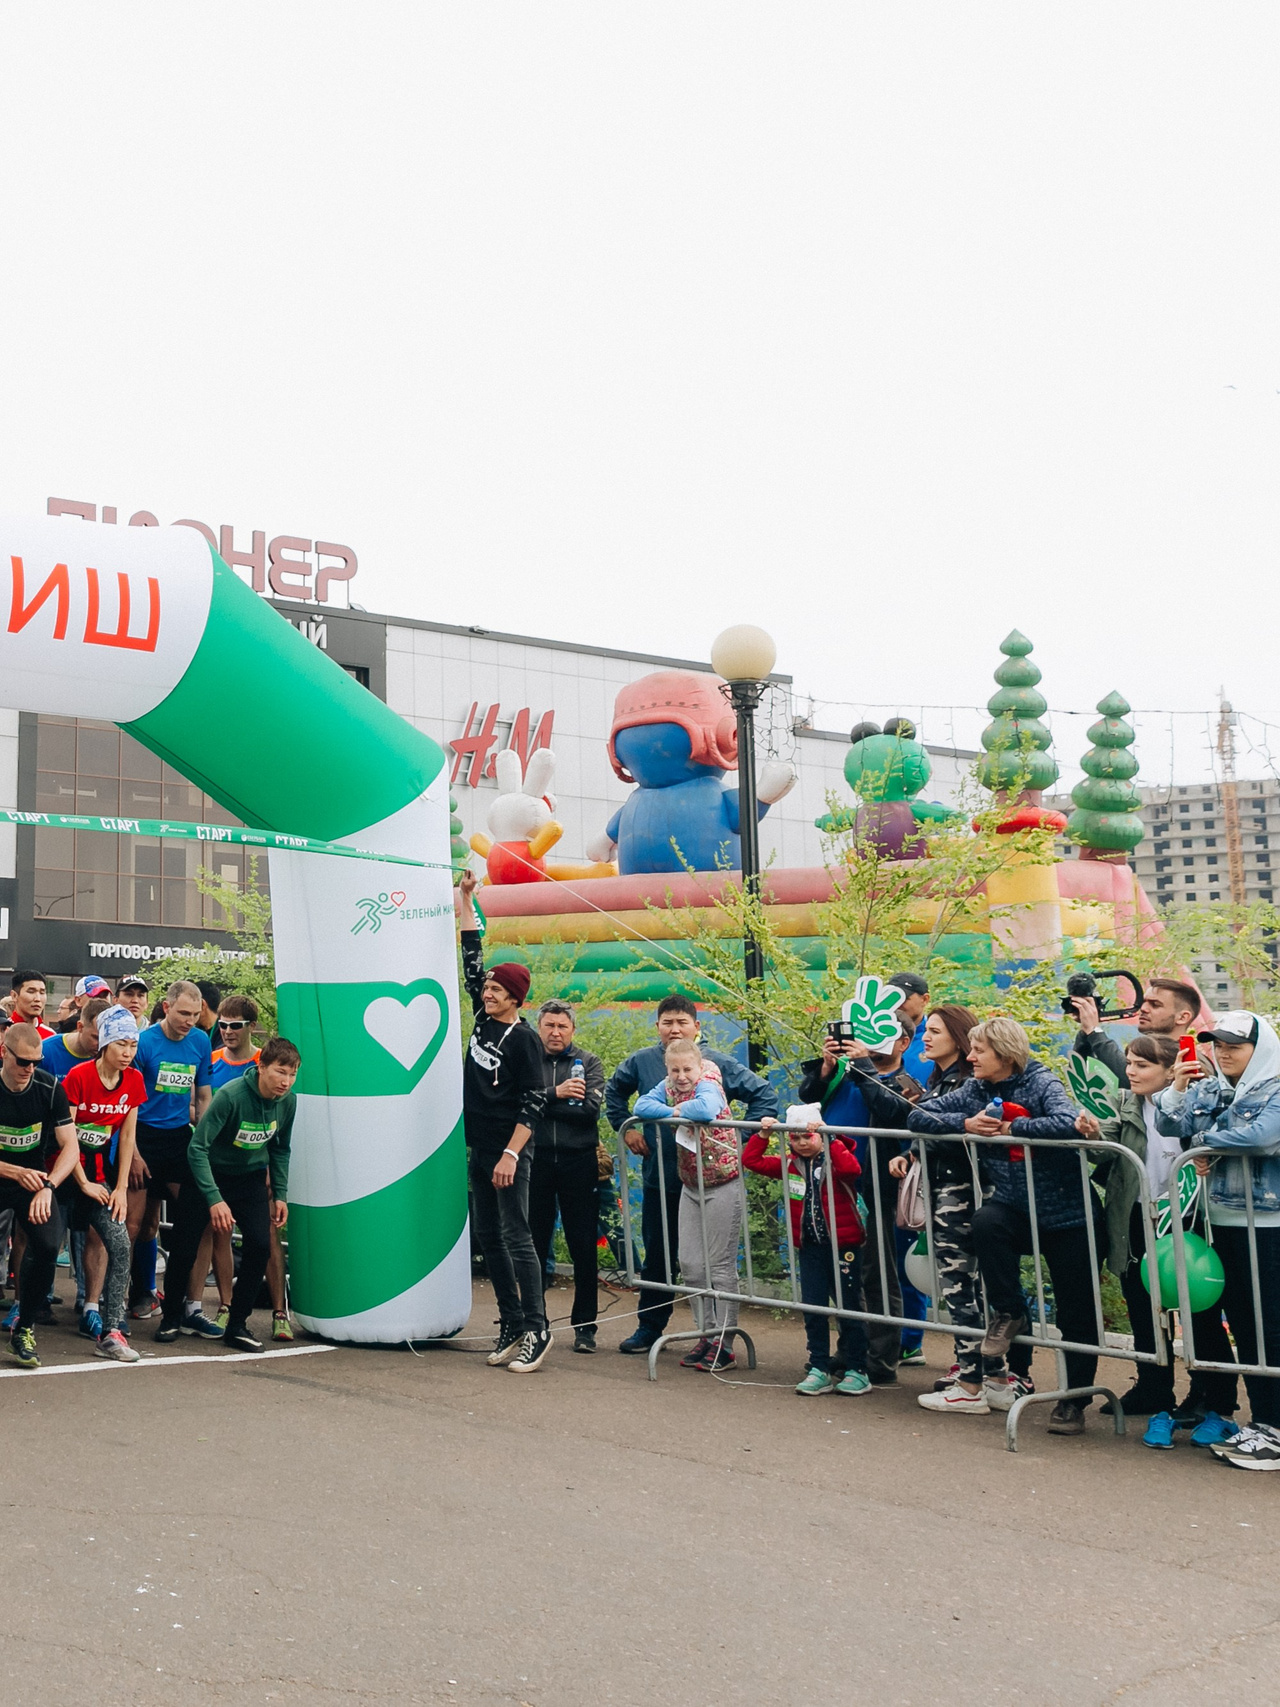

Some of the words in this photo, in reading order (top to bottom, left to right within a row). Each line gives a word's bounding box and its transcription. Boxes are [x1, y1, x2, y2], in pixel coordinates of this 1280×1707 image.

[47, 497, 358, 602] НЕР
[6, 811, 51, 824] СТАРТ
[99, 817, 141, 832] СТАРТ
[196, 825, 232, 841] СТАРТ
[400, 903, 441, 920] ЗЕЛЕНЫЙ
[170, 1074, 193, 1086] 0229
[10, 1133, 38, 1145] 0189
